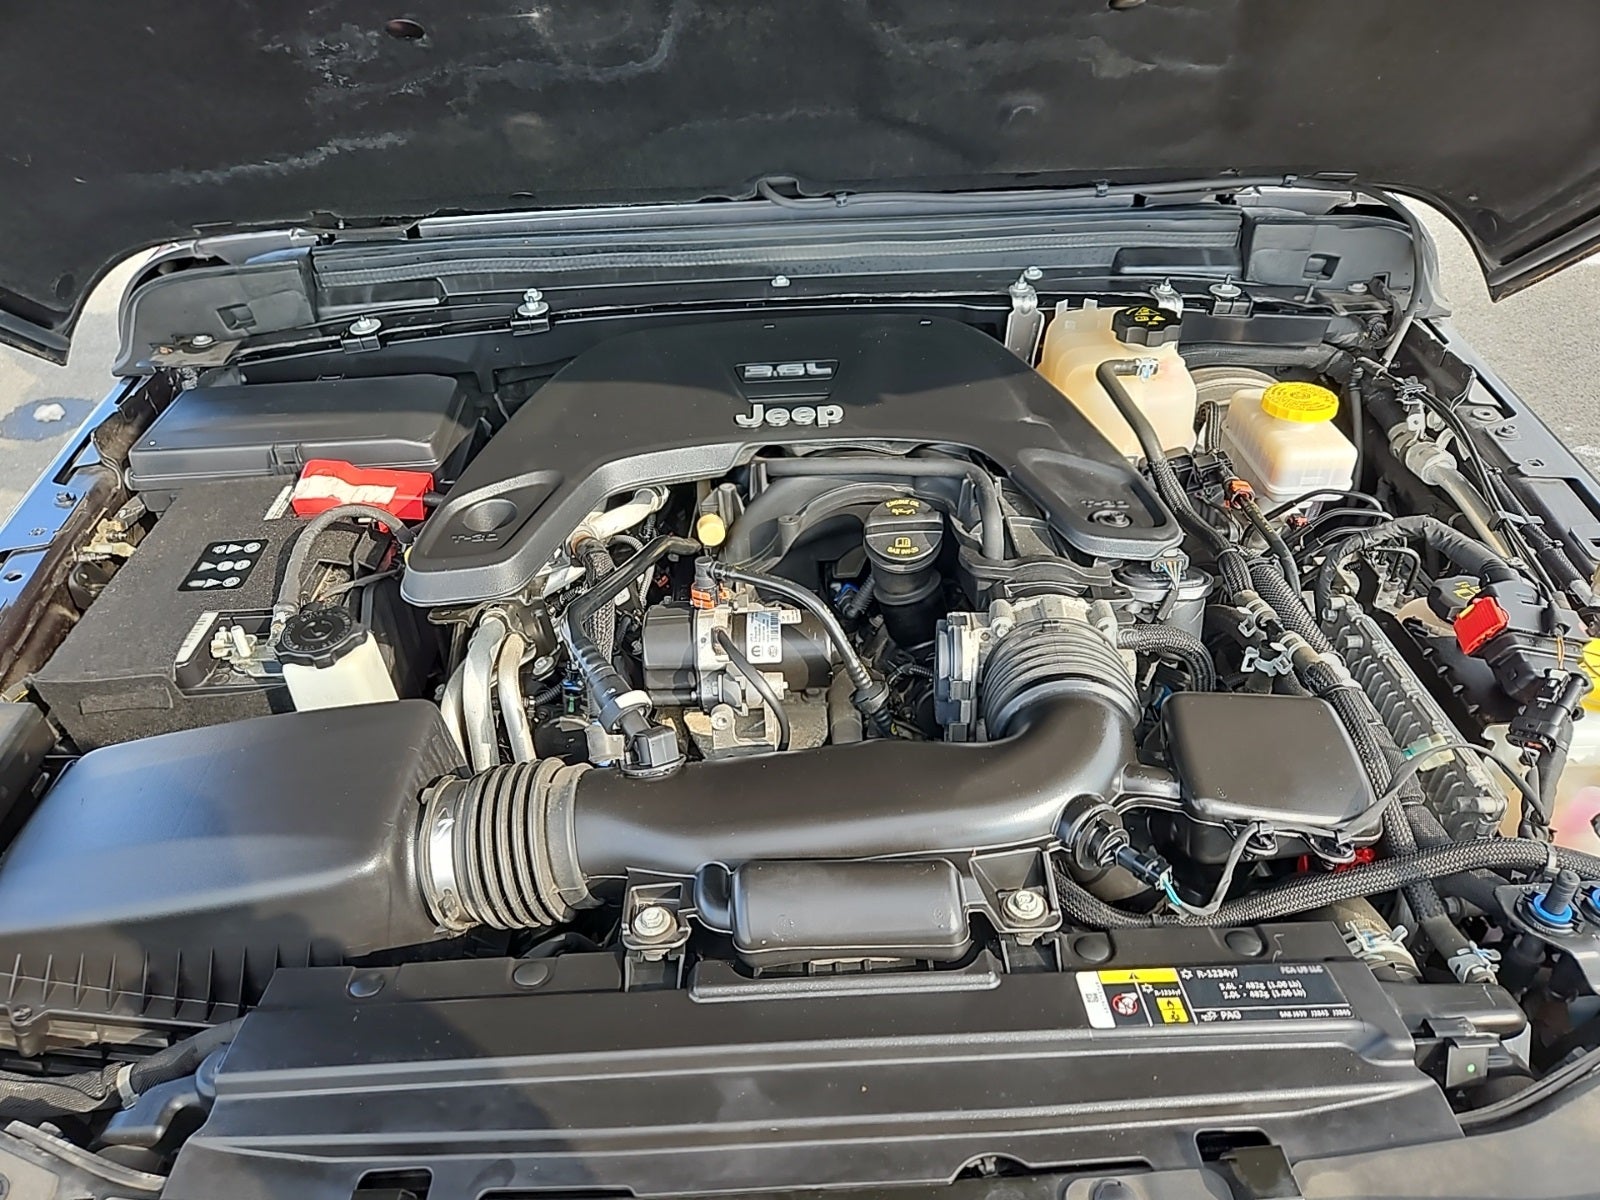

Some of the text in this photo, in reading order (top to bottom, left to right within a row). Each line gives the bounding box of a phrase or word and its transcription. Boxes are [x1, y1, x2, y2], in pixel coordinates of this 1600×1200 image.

[744, 362, 833, 379] 3.6L
[735, 403, 844, 429] Jeep
[885, 498, 920, 508] ENGINE OIL
[1196, 967, 1238, 979] R-1234yf
[1280, 965, 1324, 974] FCA US LLC
[1220, 1010, 1242, 1020] PAG
